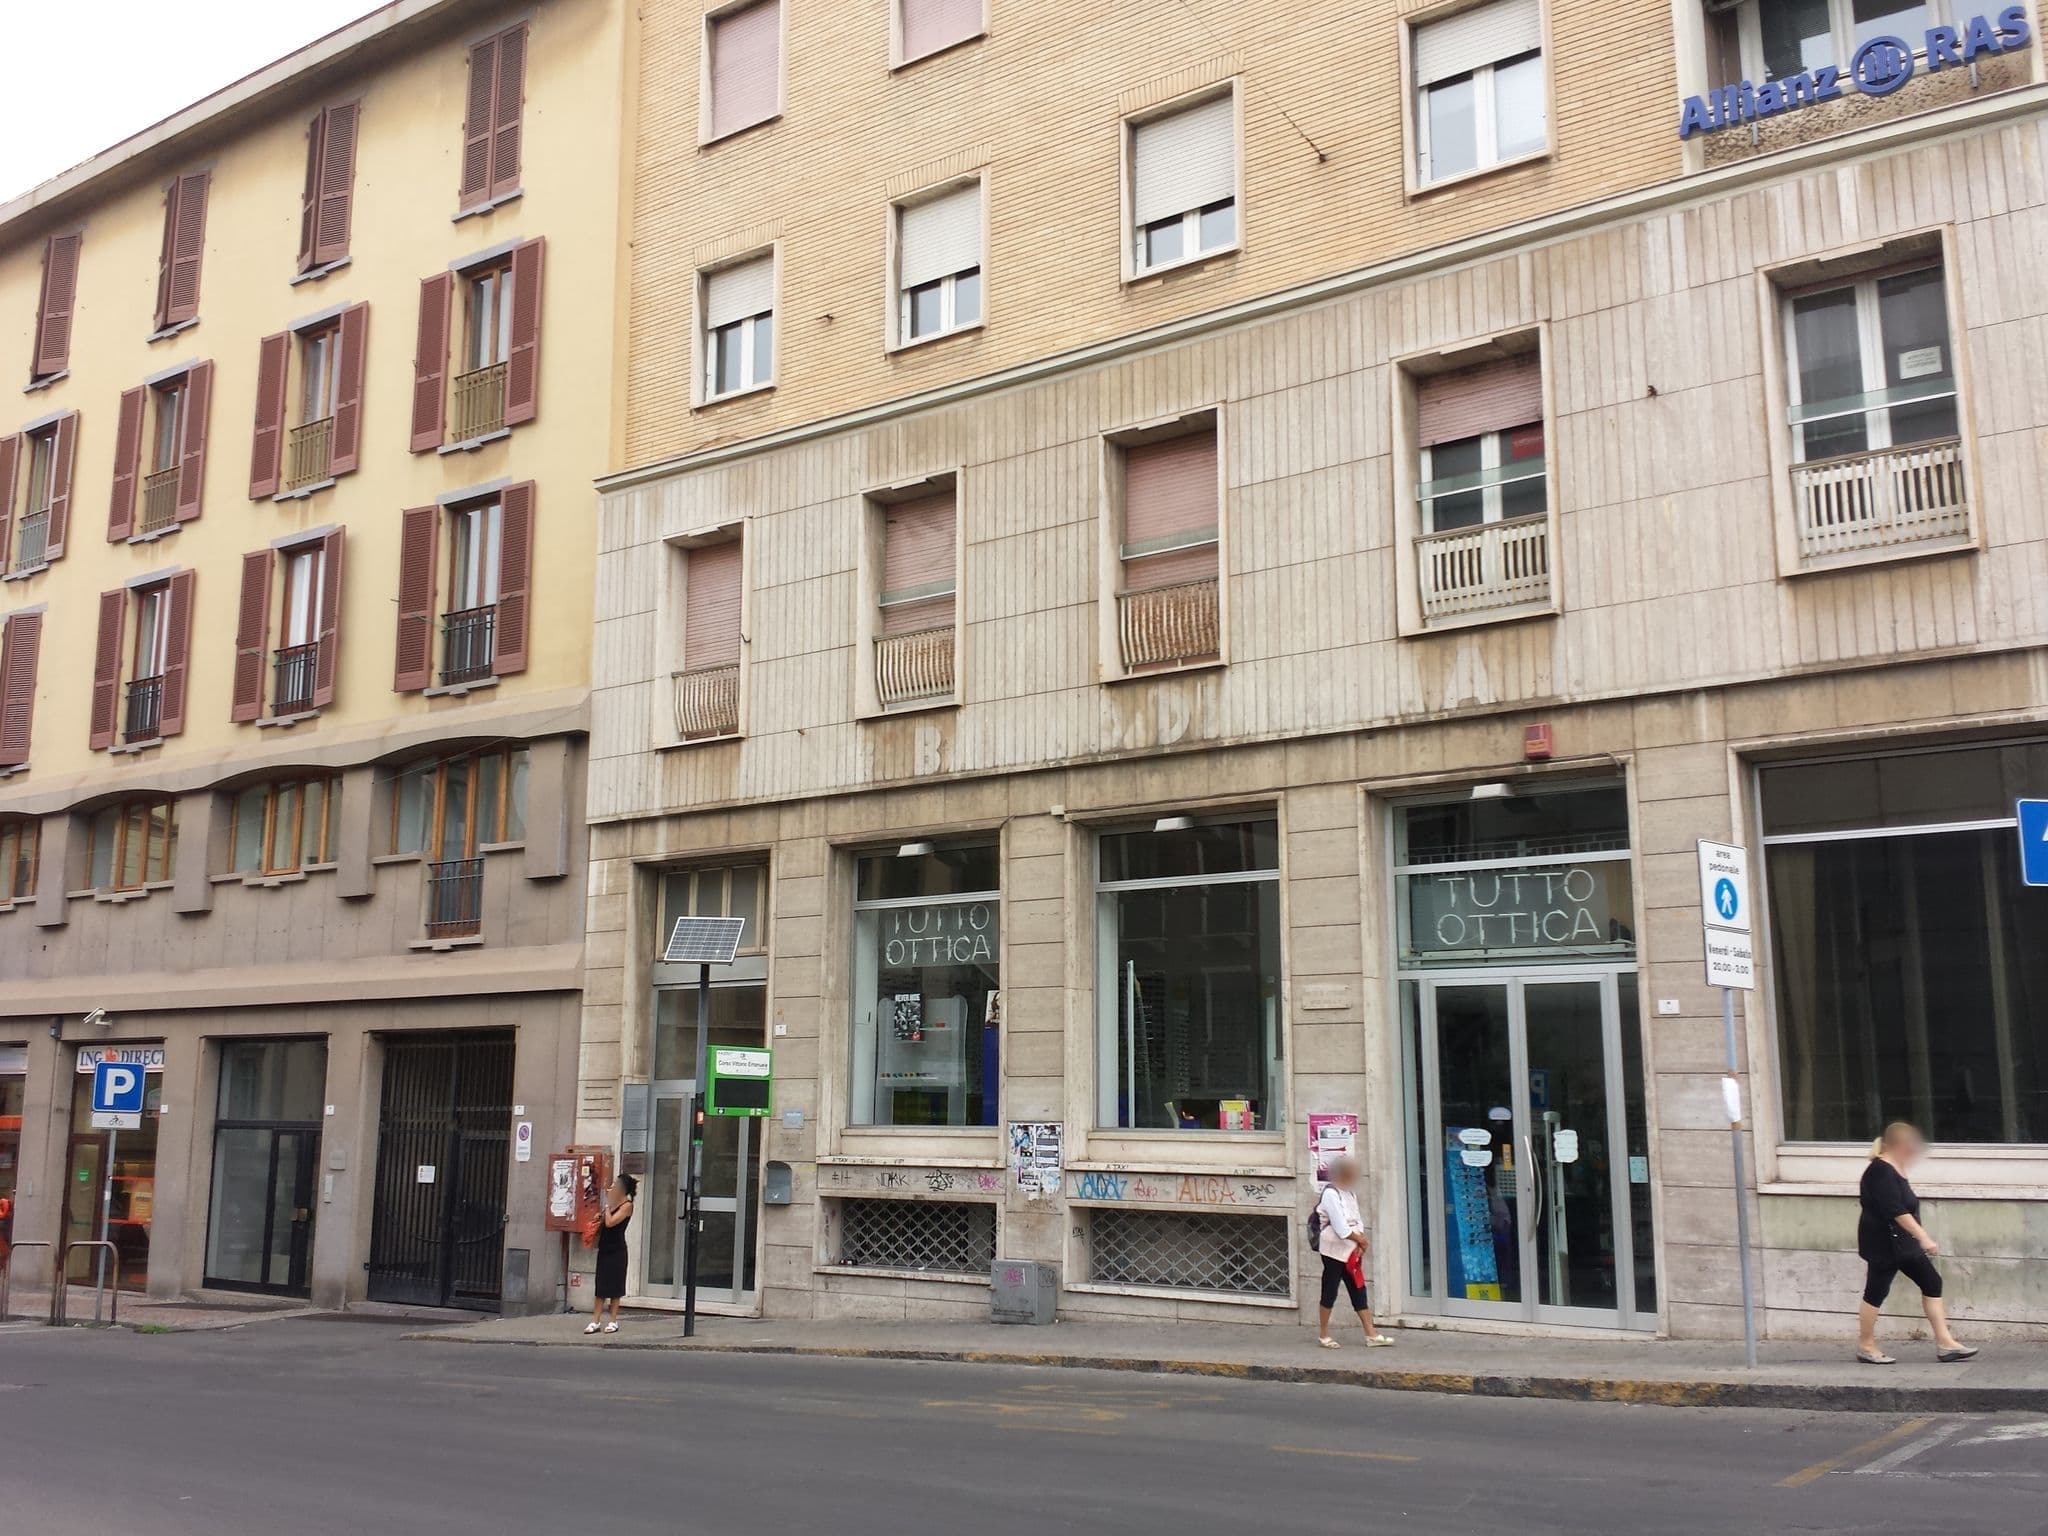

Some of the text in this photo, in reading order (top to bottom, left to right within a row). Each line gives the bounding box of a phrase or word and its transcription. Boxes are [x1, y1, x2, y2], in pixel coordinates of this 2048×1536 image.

[1679, 5, 2032, 140] Allianz RAS
[1437, 869, 1595, 907] TUTTO
[886, 903, 990, 934] TUTTO
[1436, 907, 1601, 945] OTTICA
[885, 934, 991, 965] OTTICA
[80, 1049, 165, 1066] ING DIRECT
[104, 1068, 136, 1106] P
